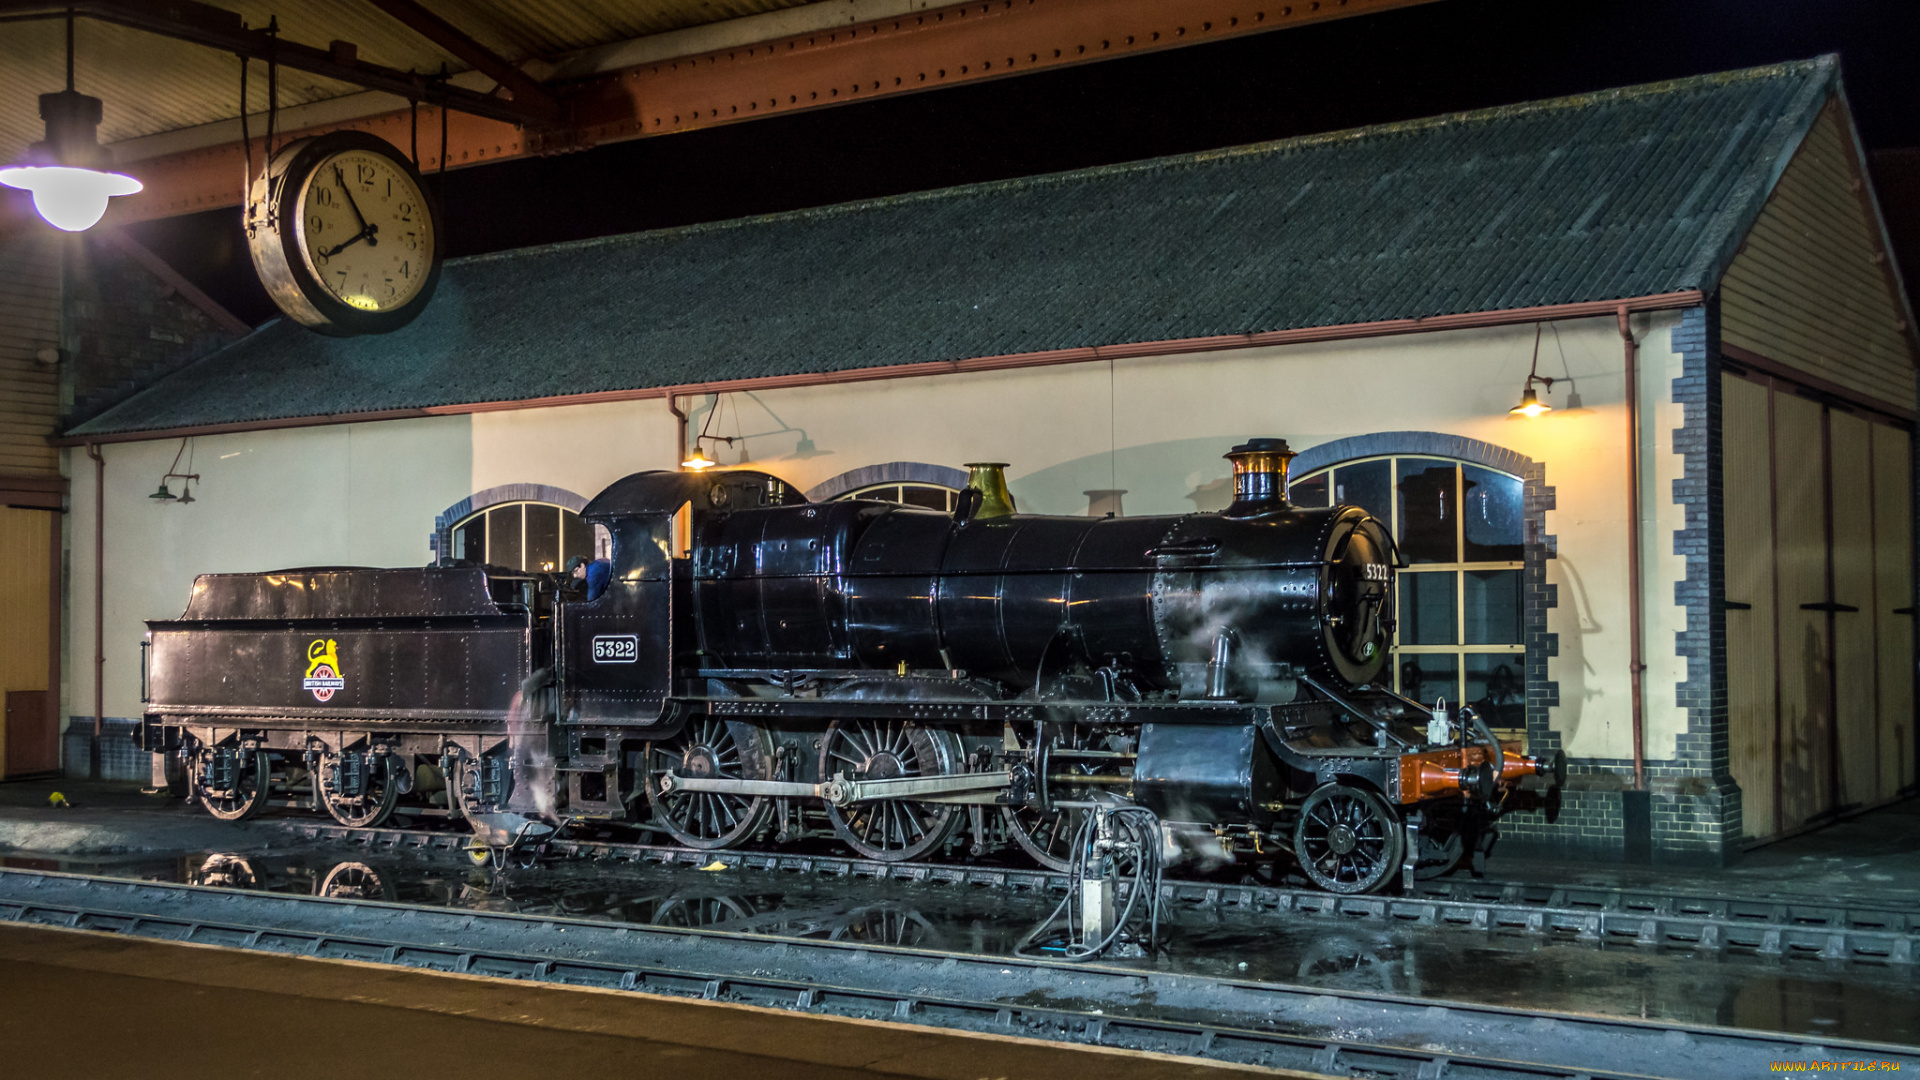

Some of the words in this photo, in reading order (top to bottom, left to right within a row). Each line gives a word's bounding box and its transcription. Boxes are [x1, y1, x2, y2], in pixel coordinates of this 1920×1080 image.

[358, 164, 375, 185] 12
[316, 186, 332, 206] 10
[387, 178, 391, 197] 1
[399, 202, 411, 222] 2
[310, 215, 322, 234] 9
[406, 231, 417, 250] 3
[317, 245, 329, 266] 8
[398, 260, 411, 278] 4
[336, 271, 347, 291] 7
[384, 278, 395, 297] 5
[1366, 563, 1388, 580] 5322
[595, 641, 635, 657] 5322
